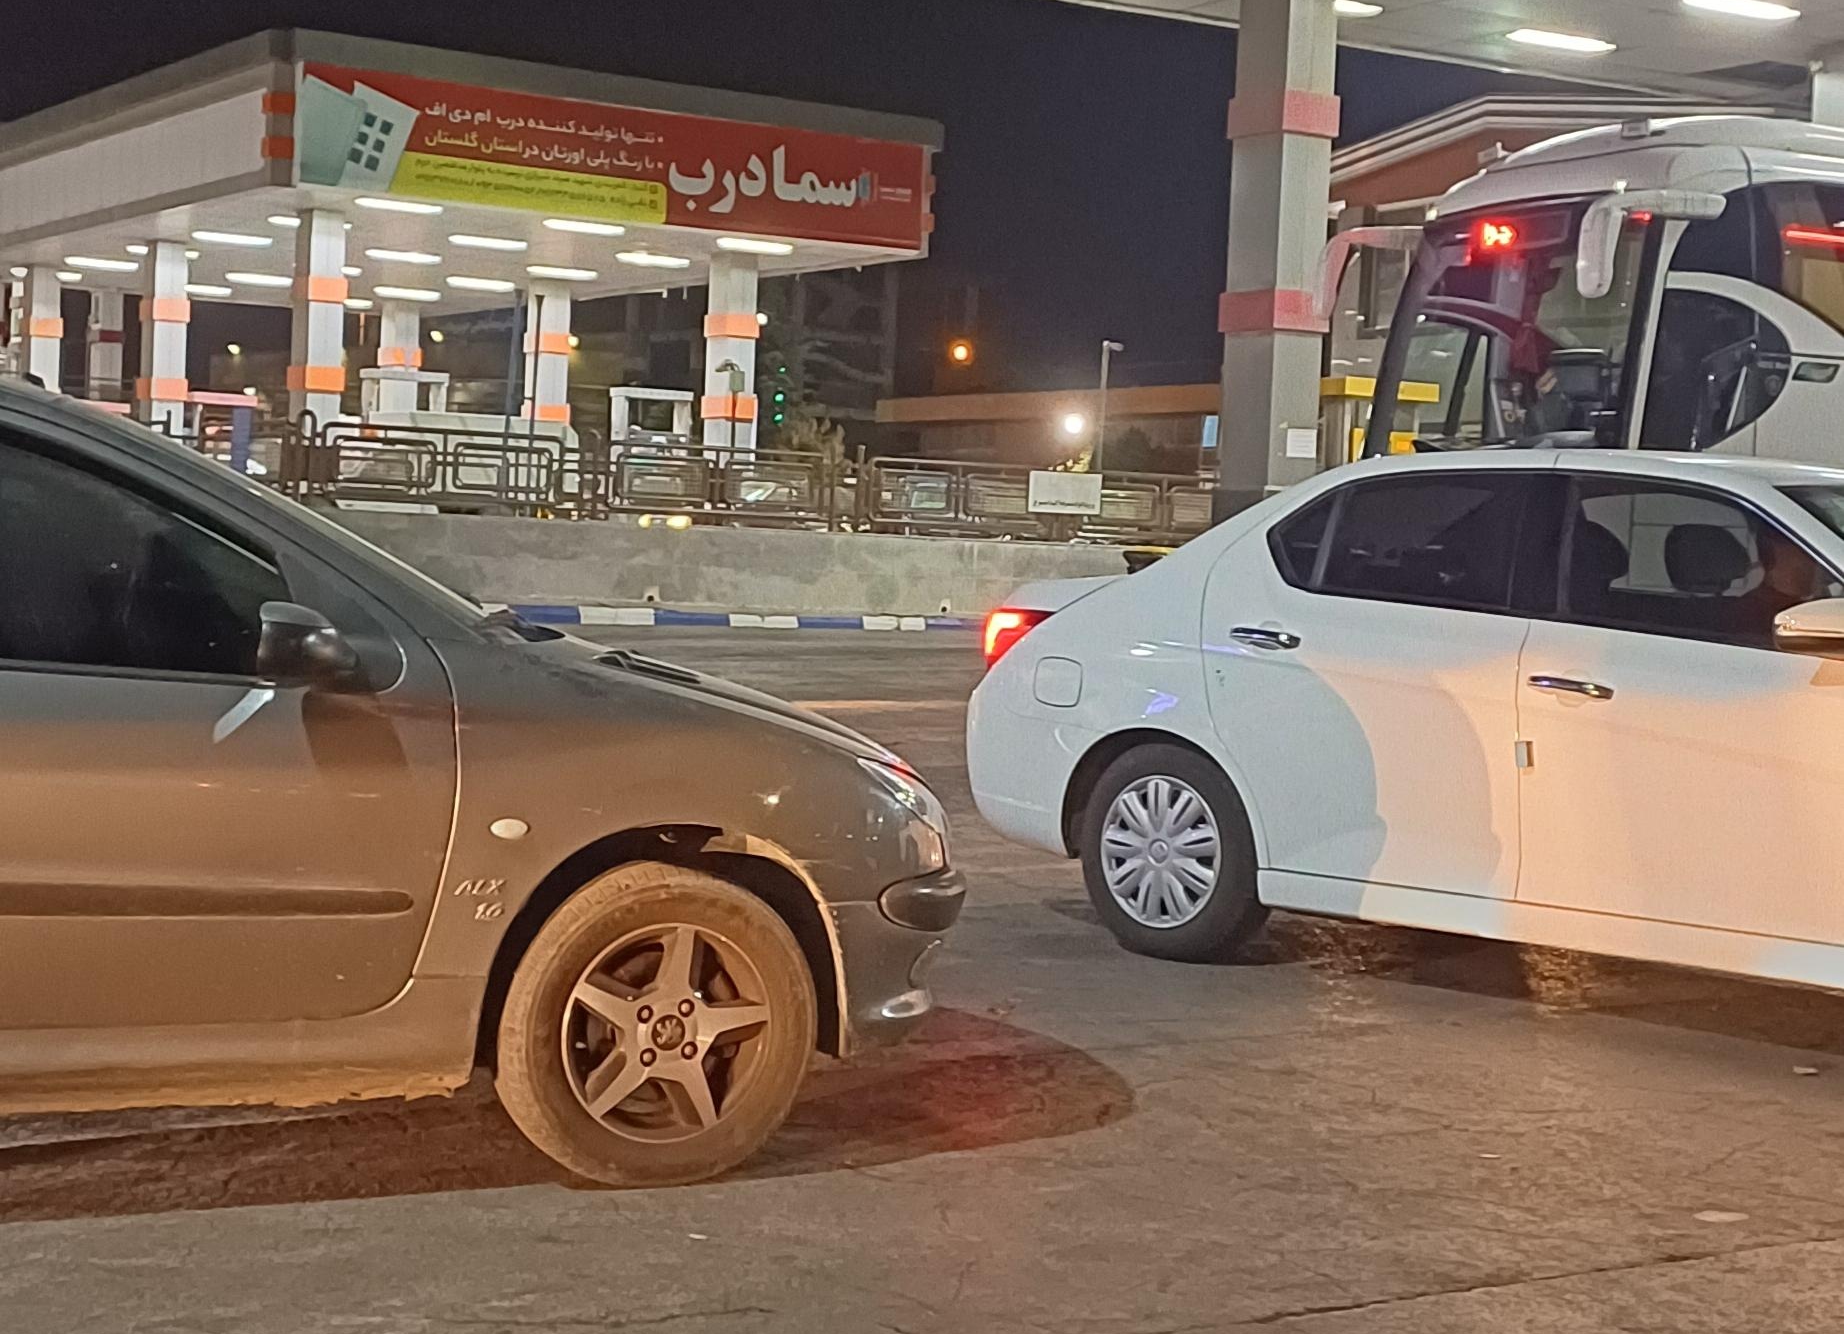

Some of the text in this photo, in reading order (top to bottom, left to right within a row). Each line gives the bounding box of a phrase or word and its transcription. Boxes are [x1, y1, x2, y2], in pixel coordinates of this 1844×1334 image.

[424, 101, 447, 117] اف
[448, 108, 472, 123] دی
[474, 108, 492, 125] ام
[496, 116, 526, 130] درب
[527, 118, 576, 134] کننده
[578, 124, 618, 143] تولید
[424, 128, 655, 172] با رنگ پلی اورتان در استان گلستان
[453, 878, 506, 897] ALX
